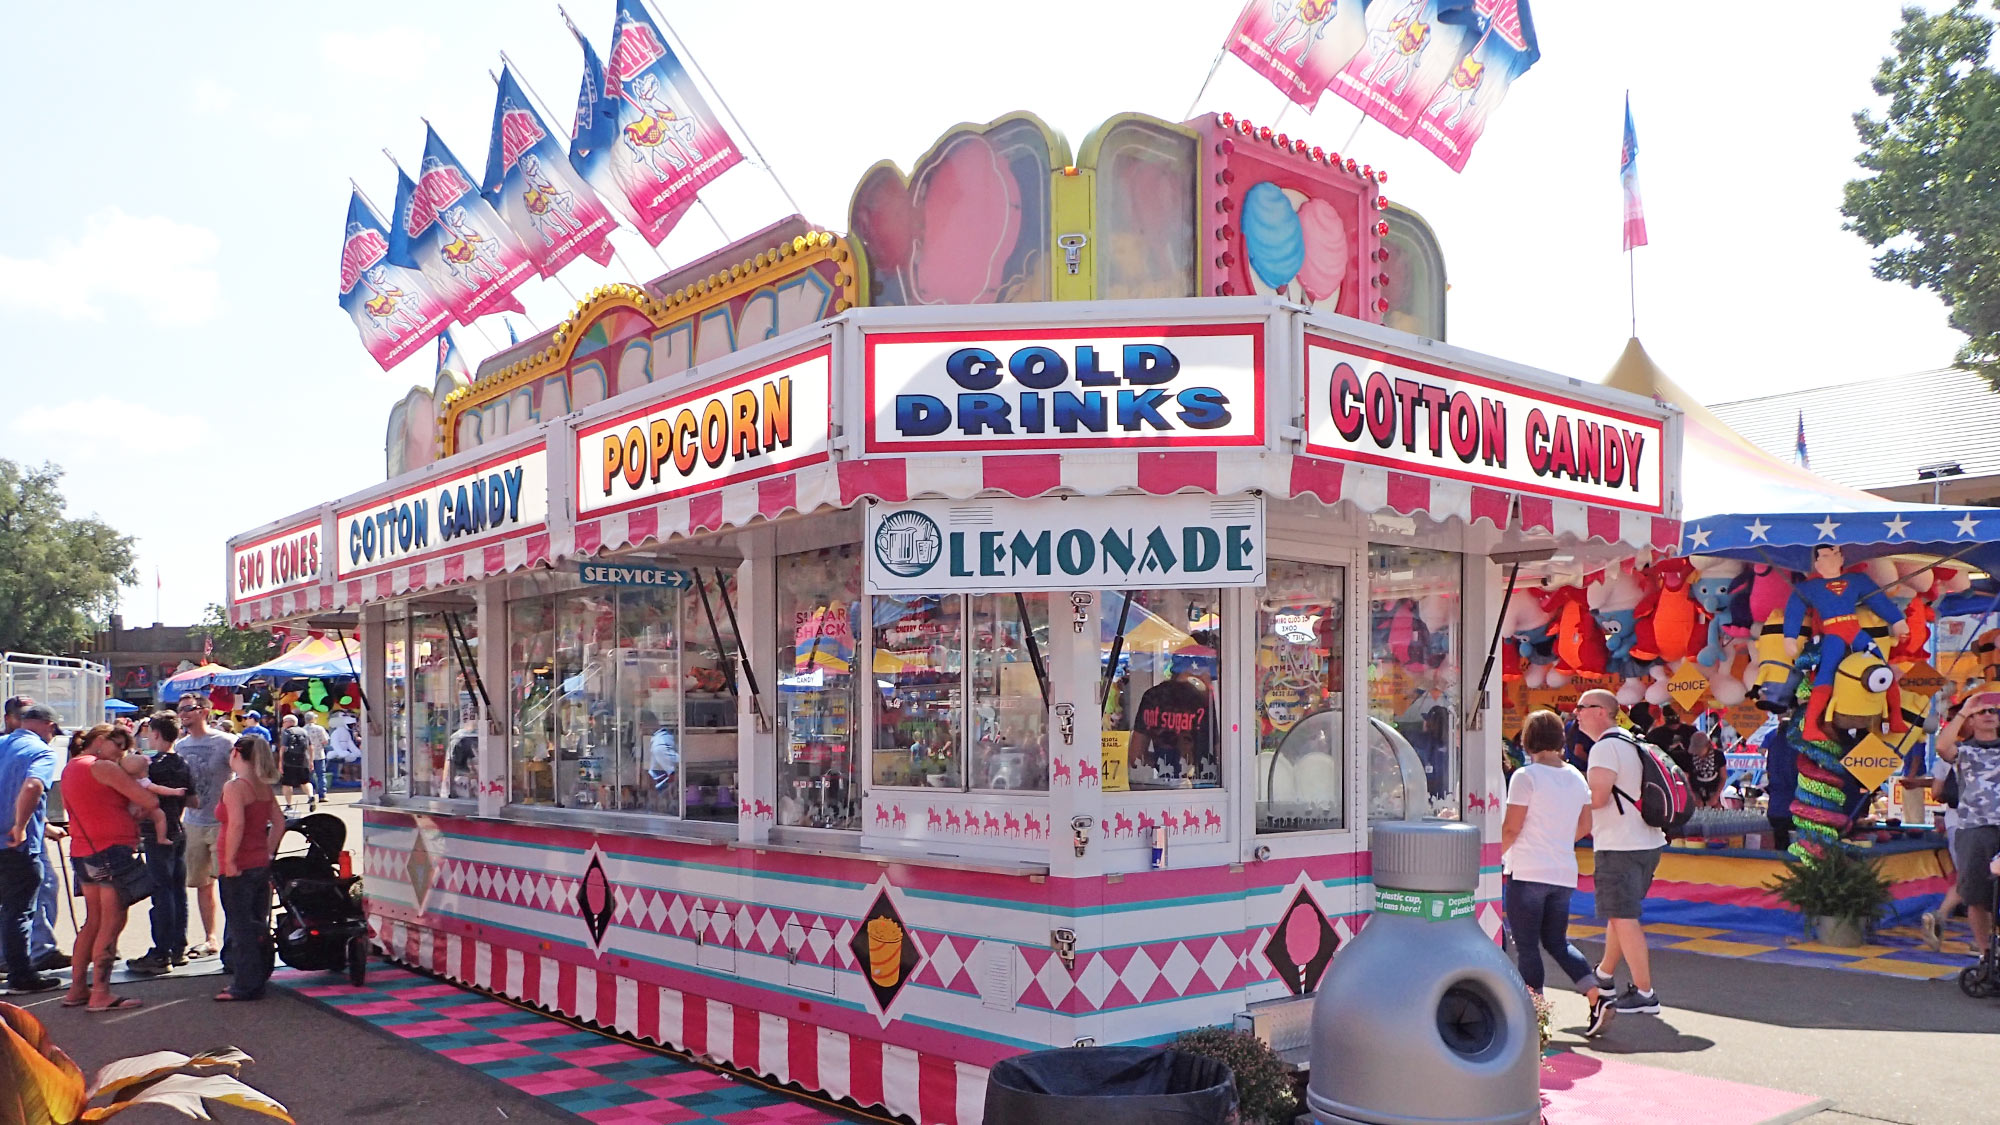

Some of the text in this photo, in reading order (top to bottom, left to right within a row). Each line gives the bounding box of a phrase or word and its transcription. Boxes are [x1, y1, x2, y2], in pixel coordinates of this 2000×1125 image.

[945, 343, 1181, 390] COLD
[895, 387, 1232, 436] DRINKS
[603, 375, 793, 497] POPCORN
[1329, 362, 1645, 492] COTTON CANDY
[349, 465, 524, 566] COTTON CANDY
[239, 531, 319, 594] SNO KONES
[949, 524, 1255, 578] LEMONADE
[584, 566, 667, 585] SERVICE
[795, 624, 846, 638] SHACK
[1666, 680, 1706, 692] CHOICE
[1899, 677, 1947, 687] CHOICE
[1143, 706, 1159, 730] got
[1843, 756, 1899, 769] CHOICE
[1381, 891, 1404, 902] plastic
[1404, 895, 1422, 905] cup,
[1384, 903, 1399, 911] cans
[1399, 903, 1421, 913] here!
